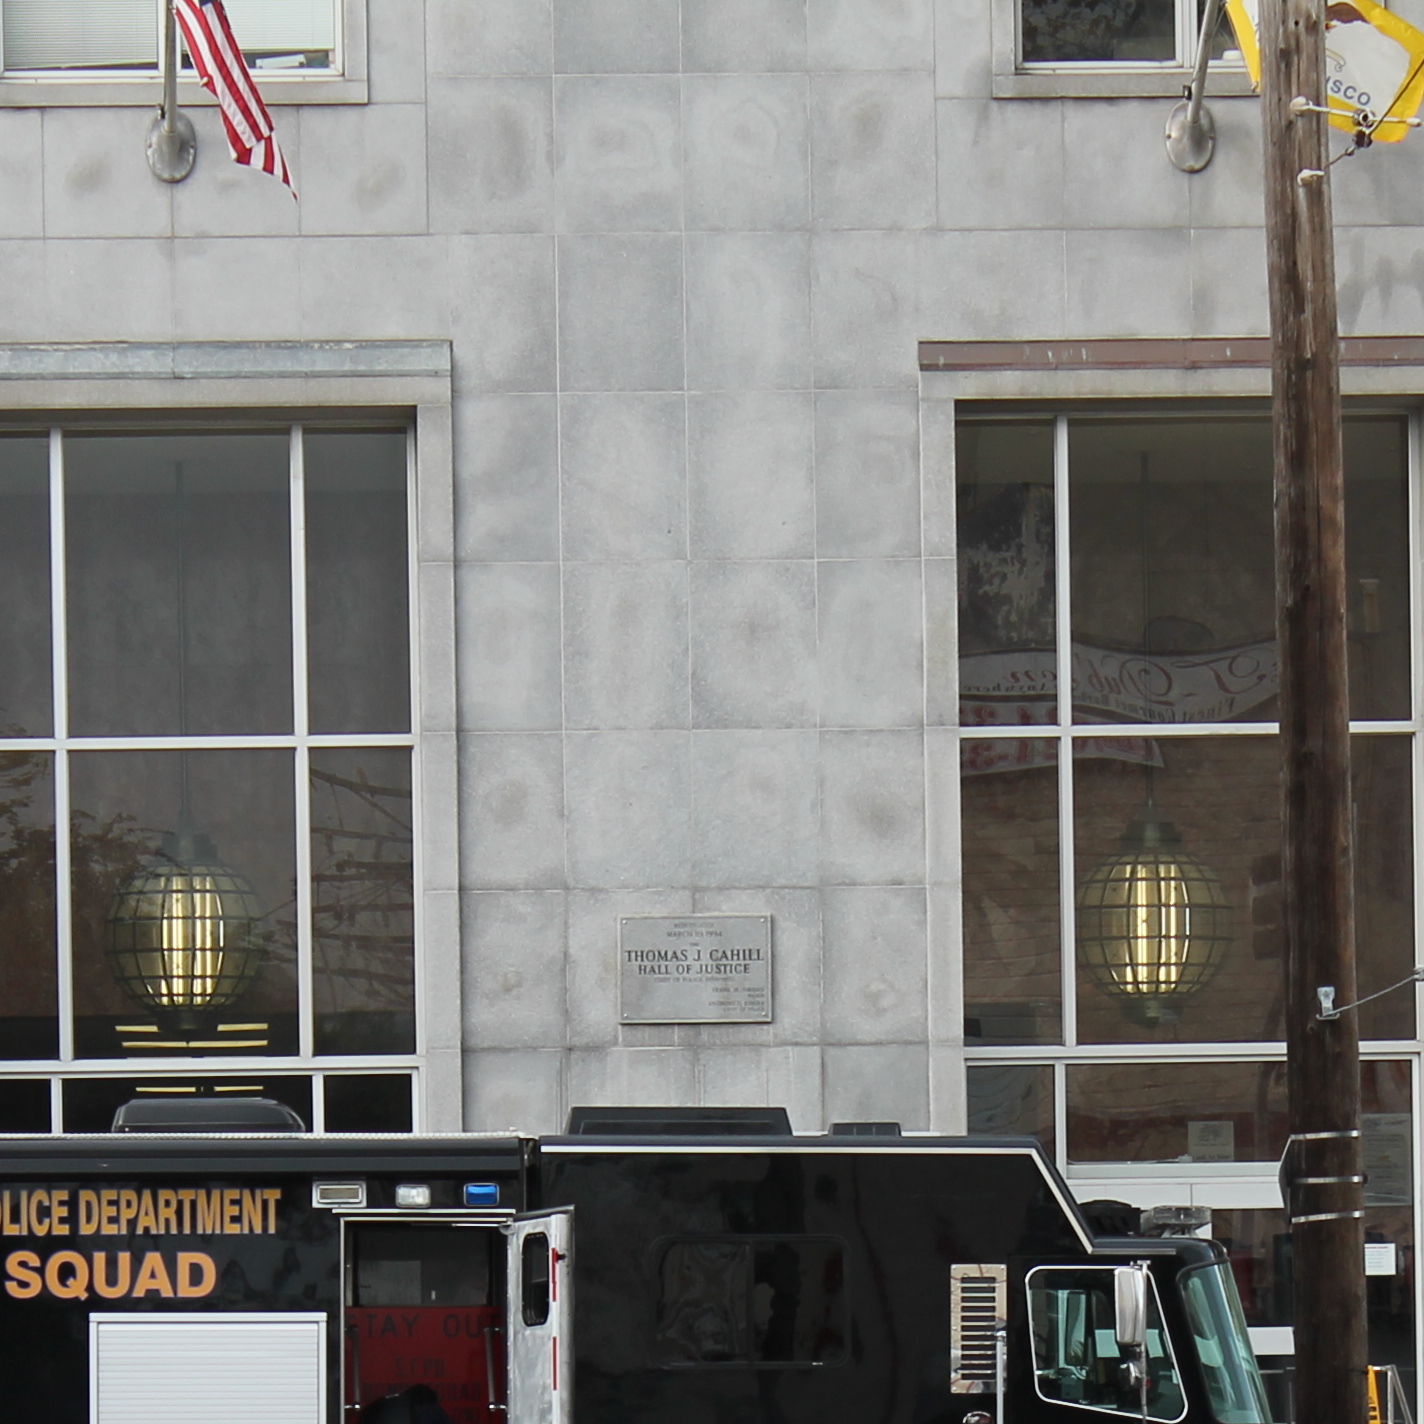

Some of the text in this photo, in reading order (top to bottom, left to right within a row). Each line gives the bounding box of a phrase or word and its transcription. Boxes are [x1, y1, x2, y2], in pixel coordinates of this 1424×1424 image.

[626, 949, 765, 962] THOMAS J CAHILL
[638, 963, 750, 975] HALL OF JUSTICE
[78, 1188, 282, 1236] DEPARTMENT
[4, 1251, 217, 1301] SQUAD
